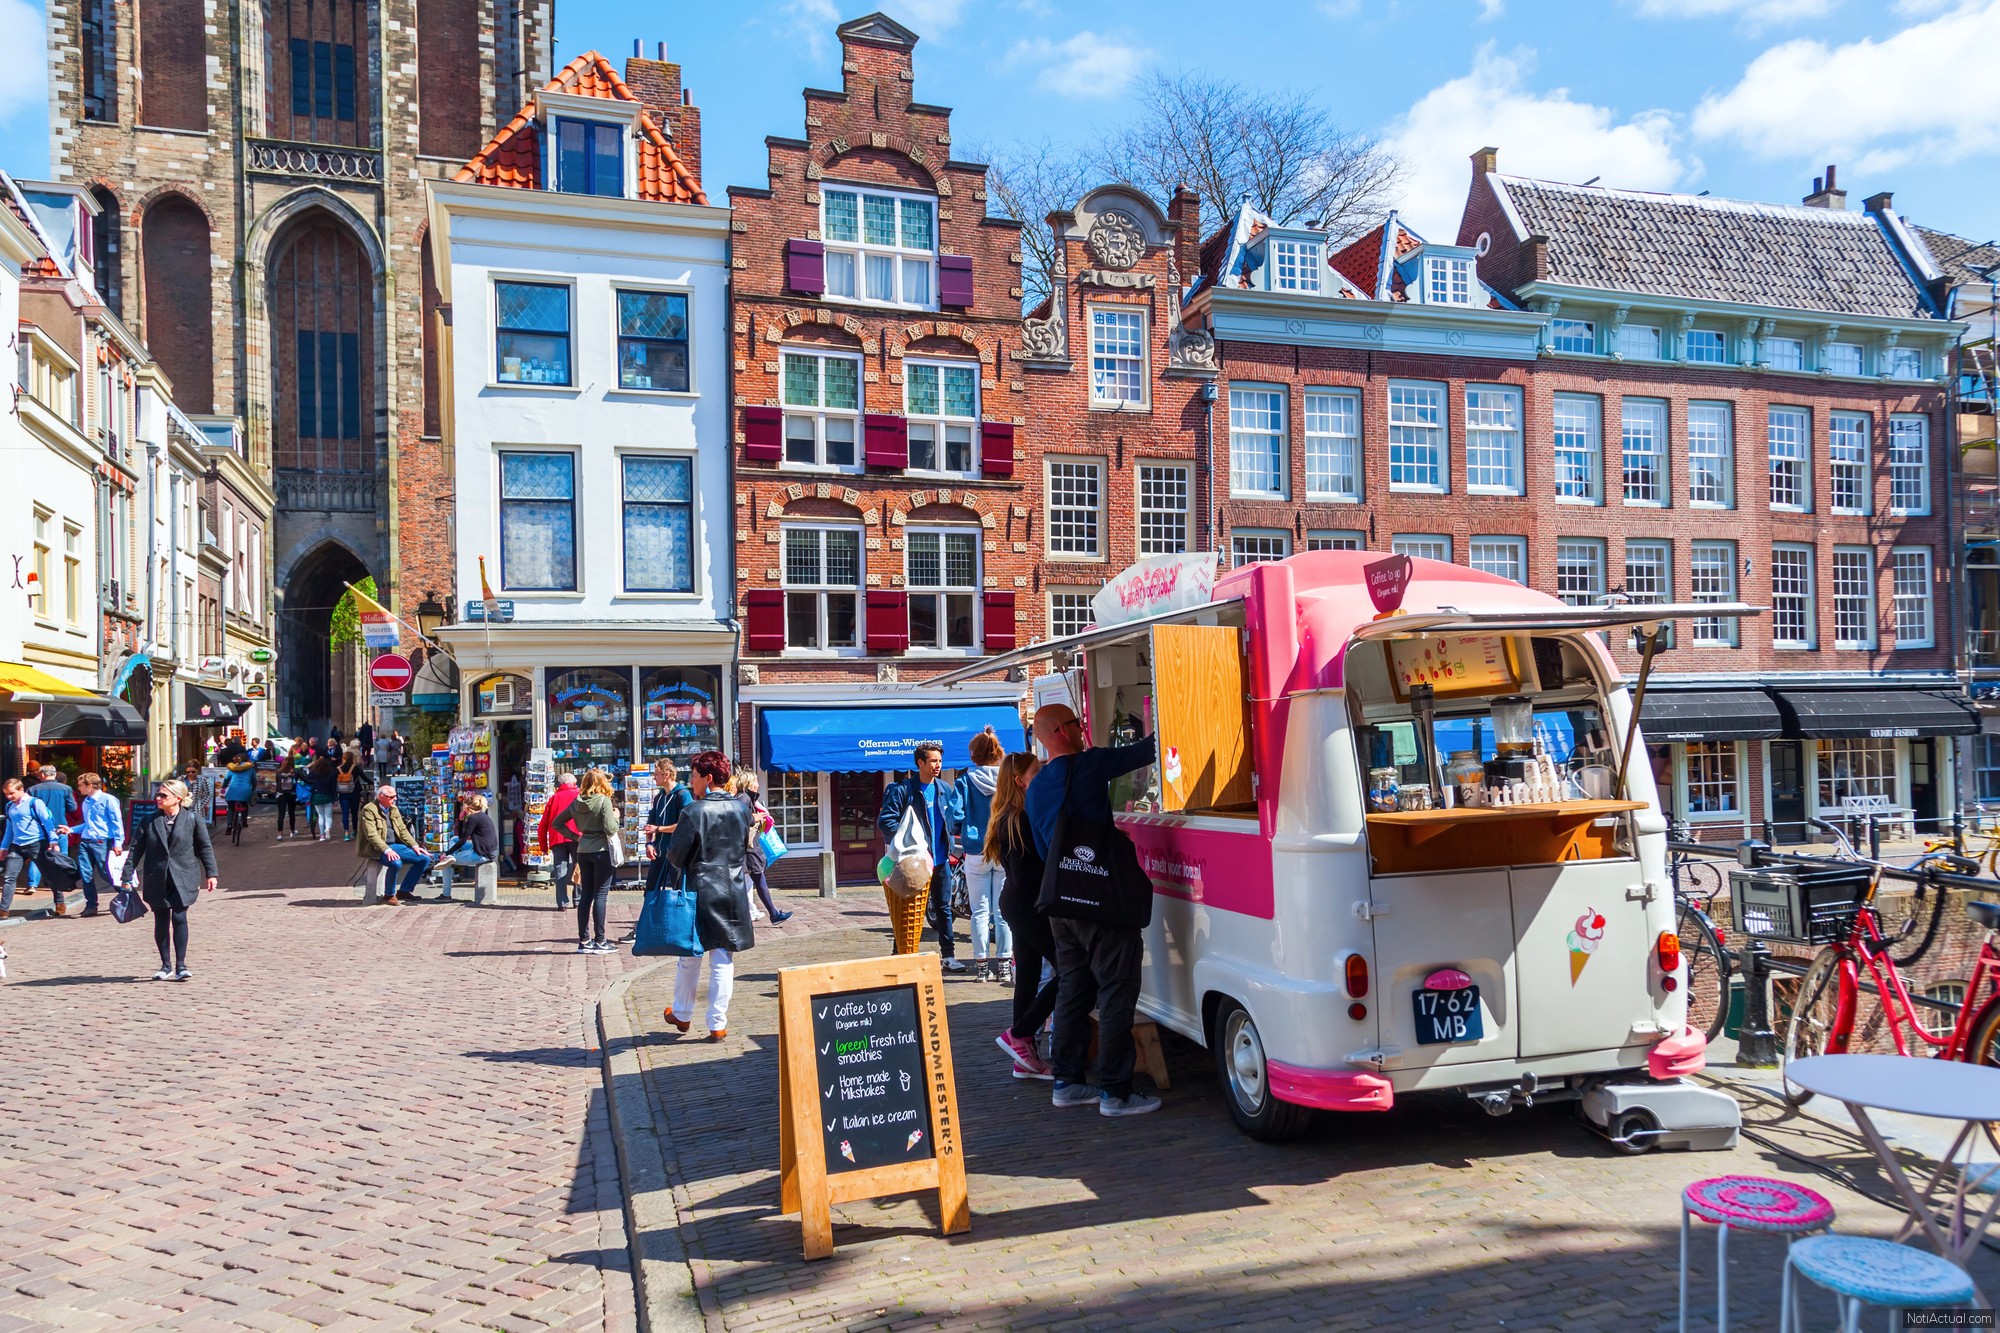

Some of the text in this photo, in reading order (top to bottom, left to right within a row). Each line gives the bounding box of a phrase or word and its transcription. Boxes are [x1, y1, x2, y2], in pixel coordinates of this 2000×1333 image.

[1109, 274, 1131, 283] 1731
[1371, 569, 1401, 586] Coffee to go
[556, 683, 588, 703] Holland
[648, 682, 679, 701] Holland
[865, 748, 916, 757] Juwelier Antiquair
[1063, 856, 1083, 866] FRED
[1151, 859, 1167, 874] smelt
[1167, 861, 1182, 876] voor
[833, 1000, 892, 1017] Coffee to go
[1418, 989, 1475, 1015] 17-62
[835, 1016, 873, 1030] (Organic milk)
[1433, 1015, 1467, 1039] MB
[835, 1030, 917, 1056] (green) Fresh fruit
[838, 1049, 882, 1065] smoothies
[840, 1070, 891, 1088] Home made
[924, 985, 954, 1156] BRANDMEESTER'S
[841, 1084, 886, 1101] Milkshakes
[842, 1109, 917, 1130] Italian ice cream
